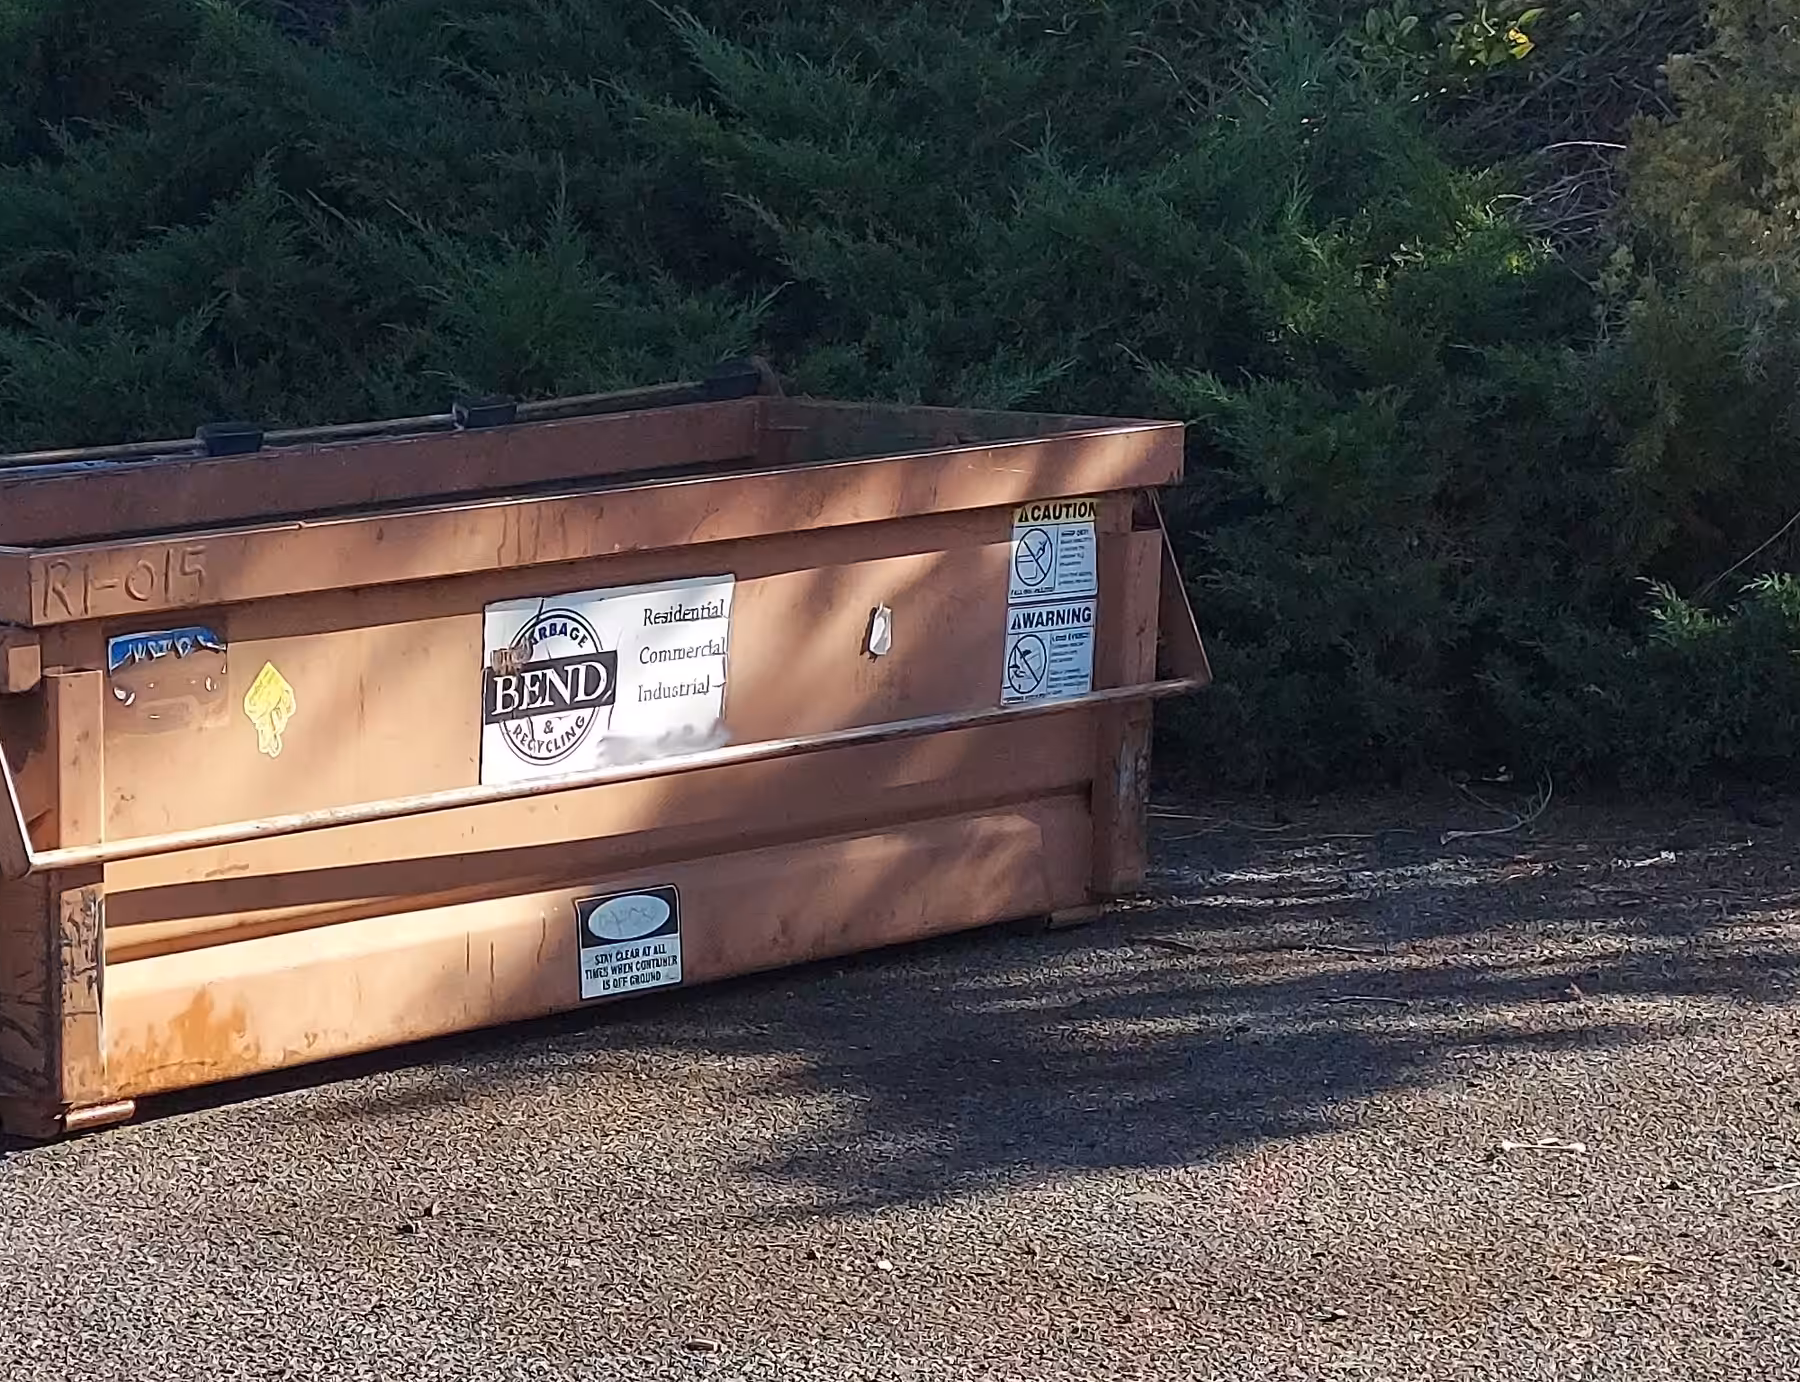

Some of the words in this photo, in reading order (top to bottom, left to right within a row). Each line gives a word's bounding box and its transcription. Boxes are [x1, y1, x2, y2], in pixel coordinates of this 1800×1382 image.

[1030, 501, 1097, 522] CAUTION
[643, 598, 725, 626] Residential
[1022, 606, 1092, 629] WARNING
[524, 621, 589, 650] ARBAGE
[639, 636, 726, 665] Commercial
[491, 660, 608, 717] BEND
[637, 674, 710, 702] Industrial
[512, 714, 586, 754] RECYCLING
[543, 719, 555, 734] &
[594, 952, 613, 965] STAY
[615, 947, 640, 961] CLEAR
[642, 945, 652, 956] AT
[653, 943, 667, 955] ALL
[585, 967, 609, 980] TIMES
[611, 961, 633, 975] WHEN
[635, 955, 678, 972] CONTAINER
[602, 979, 611, 991] IS
[613, 975, 628, 989] OFF
[629, 970, 661, 986] GROUND
